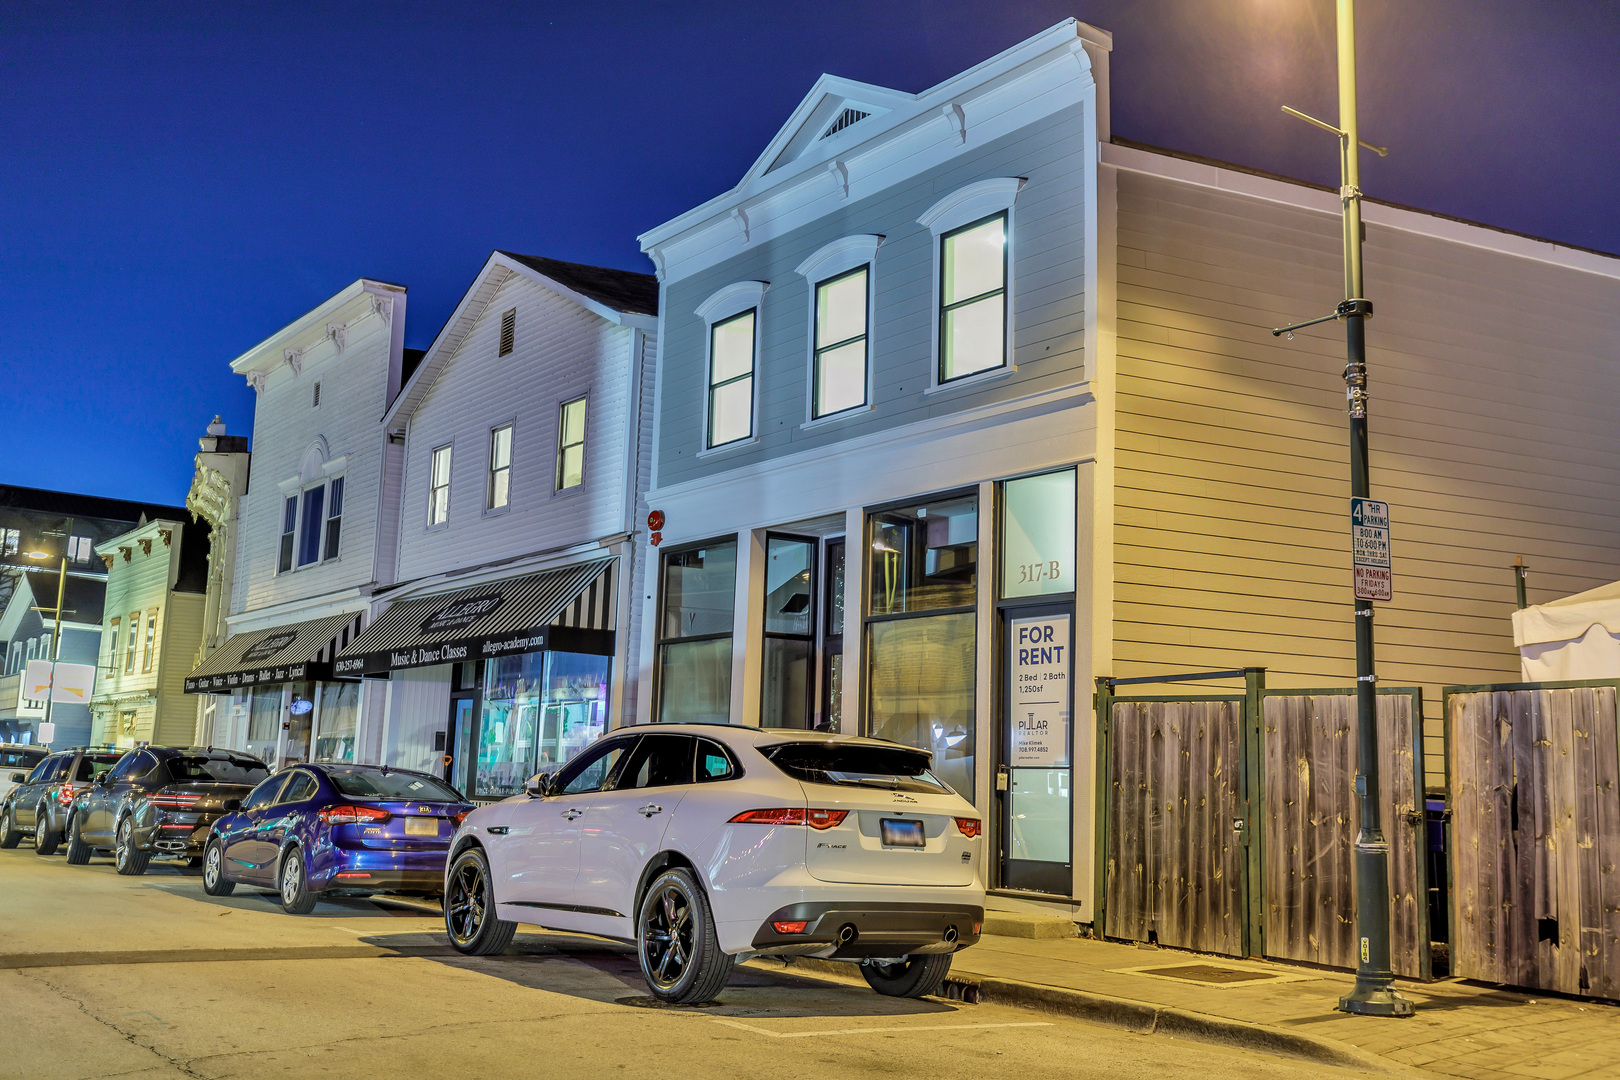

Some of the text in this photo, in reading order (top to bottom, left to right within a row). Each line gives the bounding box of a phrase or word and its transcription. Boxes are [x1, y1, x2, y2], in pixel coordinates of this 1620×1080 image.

[1353, 503, 1380, 522] 4 HR
[1364, 515, 1387, 526] PARKING
[1374, 530, 1382, 539] AM
[1357, 538, 1363, 548] TO
[1378, 541, 1387, 550] PM
[1018, 561, 1060, 584] 317-B
[1356, 568, 1389, 580] NO PARKING
[1361, 579, 1385, 588] FRIDAYS
[431, 597, 500, 621] ALLEGRO
[1019, 625, 1054, 645] FOR
[482, 635, 544, 655] allegro-academy.com
[391, 644, 468, 667] Music & Dance Classes
[1019, 646, 1064, 666] RENT
[212, 675, 223, 687] Voice
[227, 673, 239, 685] Violin
[242, 672, 255, 684] Drums
[258, 669, 271, 681] Ballet
[275, 667, 284, 679] Jazz
[289, 665, 304, 680] Lyrical
[1019, 672, 1066, 682] 2 Bed 2 Bath
[1019, 685, 1044, 693] 1,250sf
[1018, 712, 1049, 730] PILLAR
